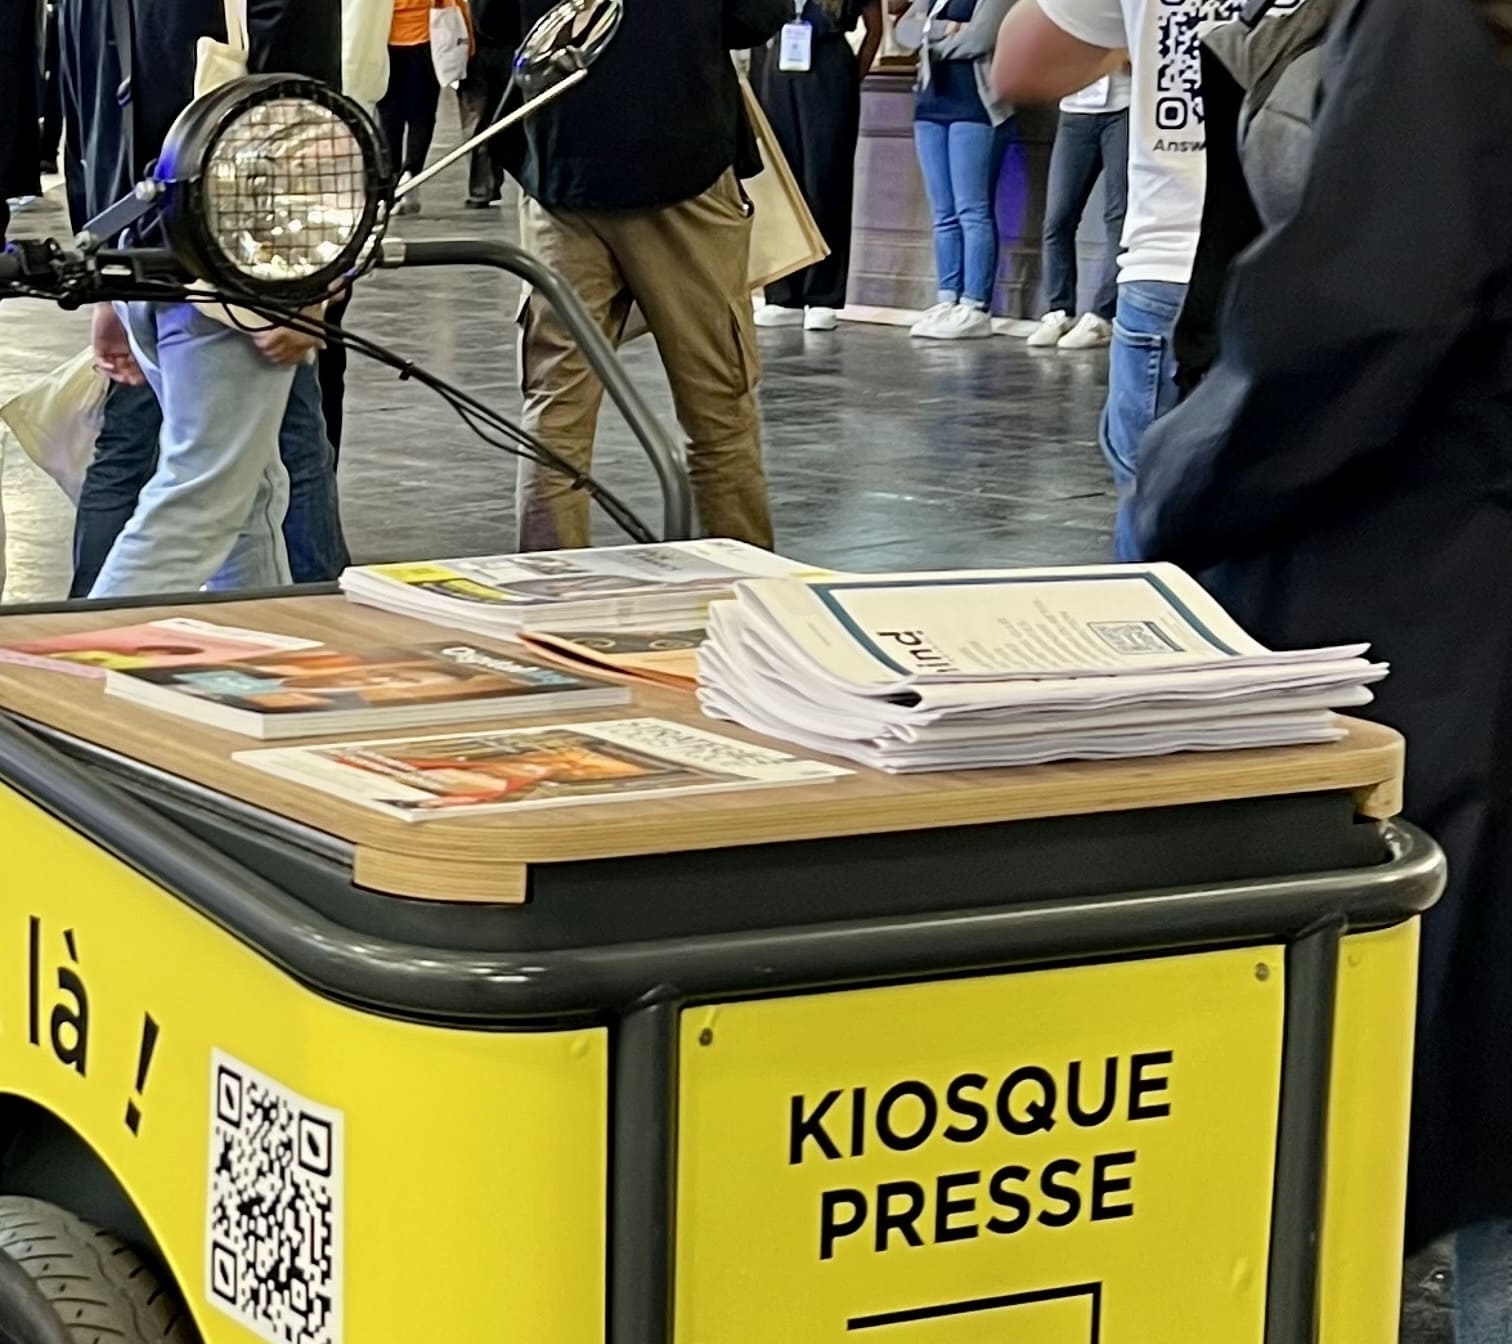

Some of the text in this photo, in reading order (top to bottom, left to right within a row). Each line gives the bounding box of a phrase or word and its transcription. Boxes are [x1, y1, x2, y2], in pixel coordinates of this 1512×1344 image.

[28, 915, 89, 1078] là
[124, 1010, 160, 1137] !
[789, 1050, 1173, 1166] KIOSQUE
[819, 1150, 1137, 1260] PRESSE
